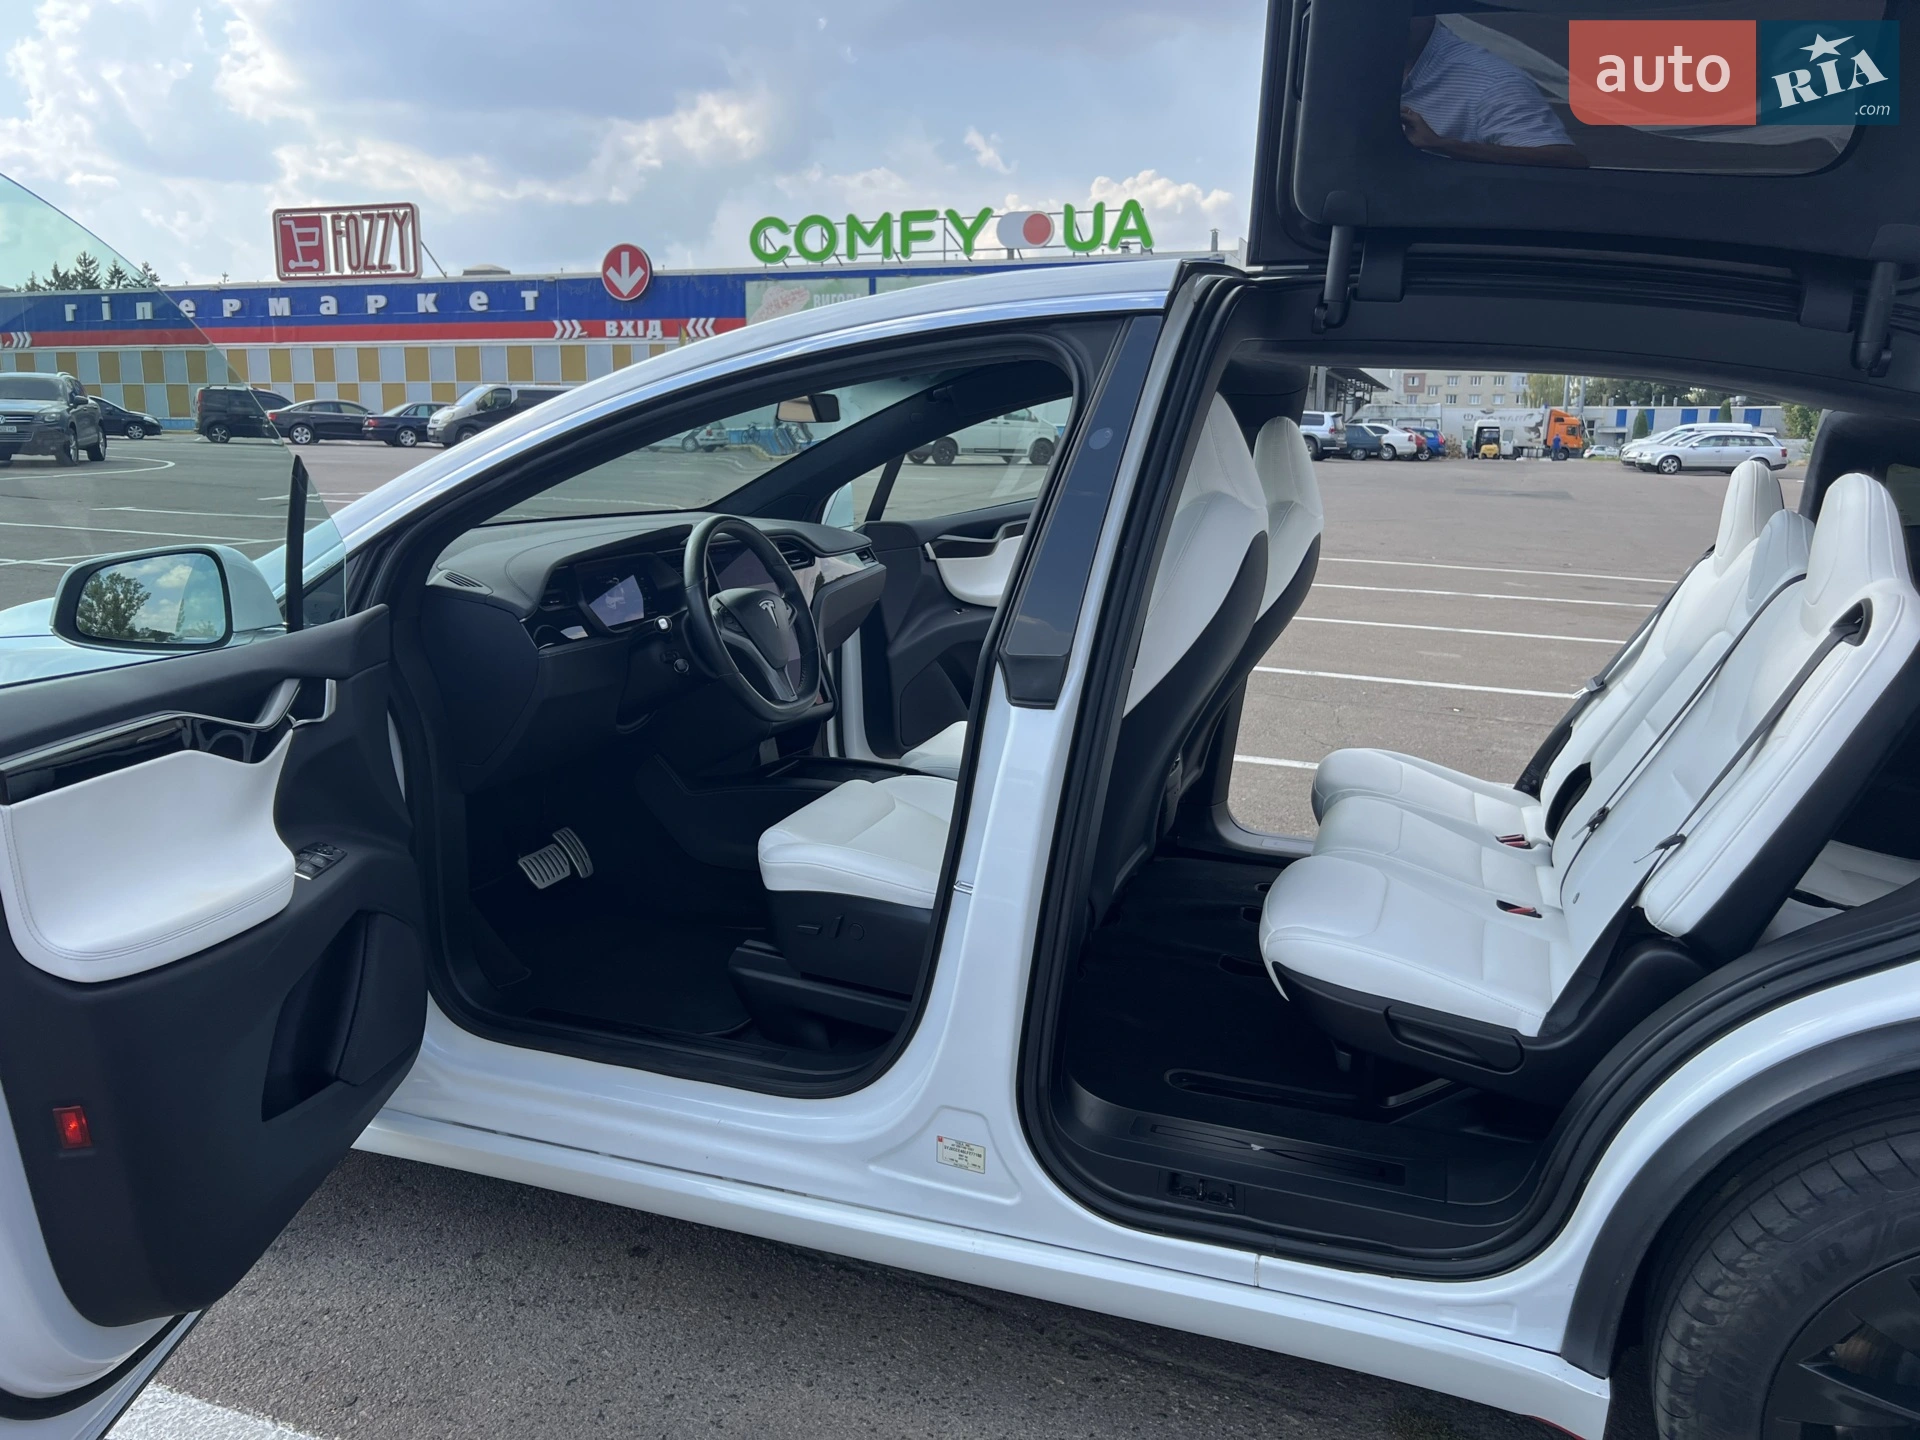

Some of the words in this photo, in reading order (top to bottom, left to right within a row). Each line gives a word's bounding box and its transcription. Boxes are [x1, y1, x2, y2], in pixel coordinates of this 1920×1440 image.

[330, 210, 410, 273] FOZZY
[749, 206, 994, 264] COMFY
[1063, 198, 1155, 253] UA
[605, 319, 663, 339] ВХІД
